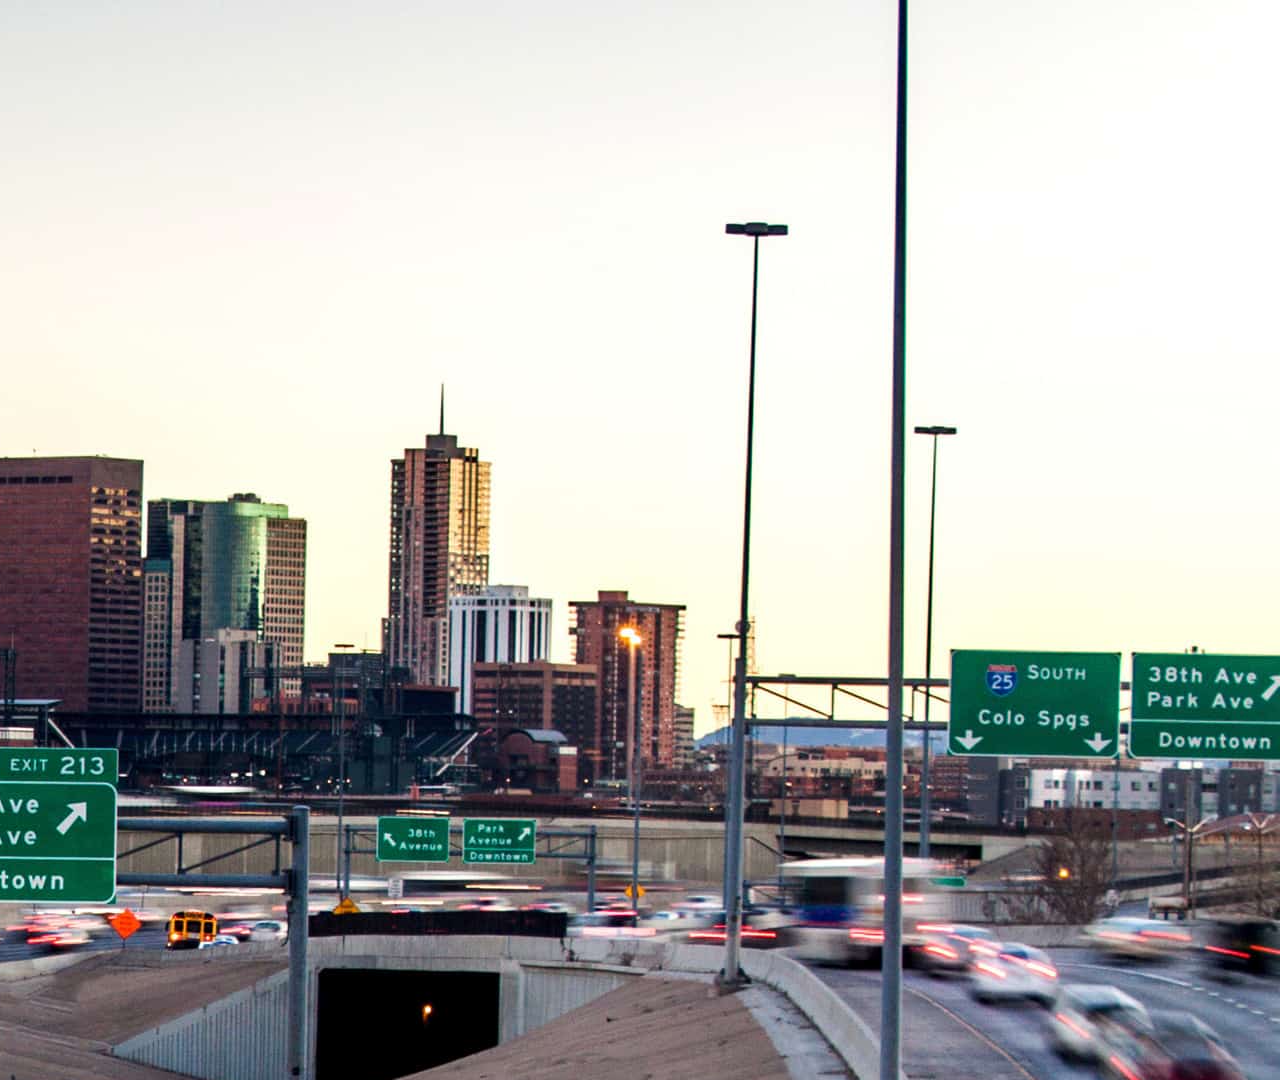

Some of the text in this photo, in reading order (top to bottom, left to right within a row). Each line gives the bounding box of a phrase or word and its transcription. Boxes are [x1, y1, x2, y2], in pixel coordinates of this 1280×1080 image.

[992, 675, 1013, 689] 25
[1149, 667, 1257, 684] 38th Ave
[1147, 692, 1254, 708] Park Ave
[978, 710, 1090, 730] Colo Spgs
[1159, 732, 1271, 749] Downtown
[11, 757, 104, 775] EXIT 213
[408, 828, 436, 838] 38th
[478, 824, 504, 833] Park
[400, 842, 442, 851] Avenue
[469, 836, 512, 845] Avenue
[470, 852, 528, 861] Downtown
